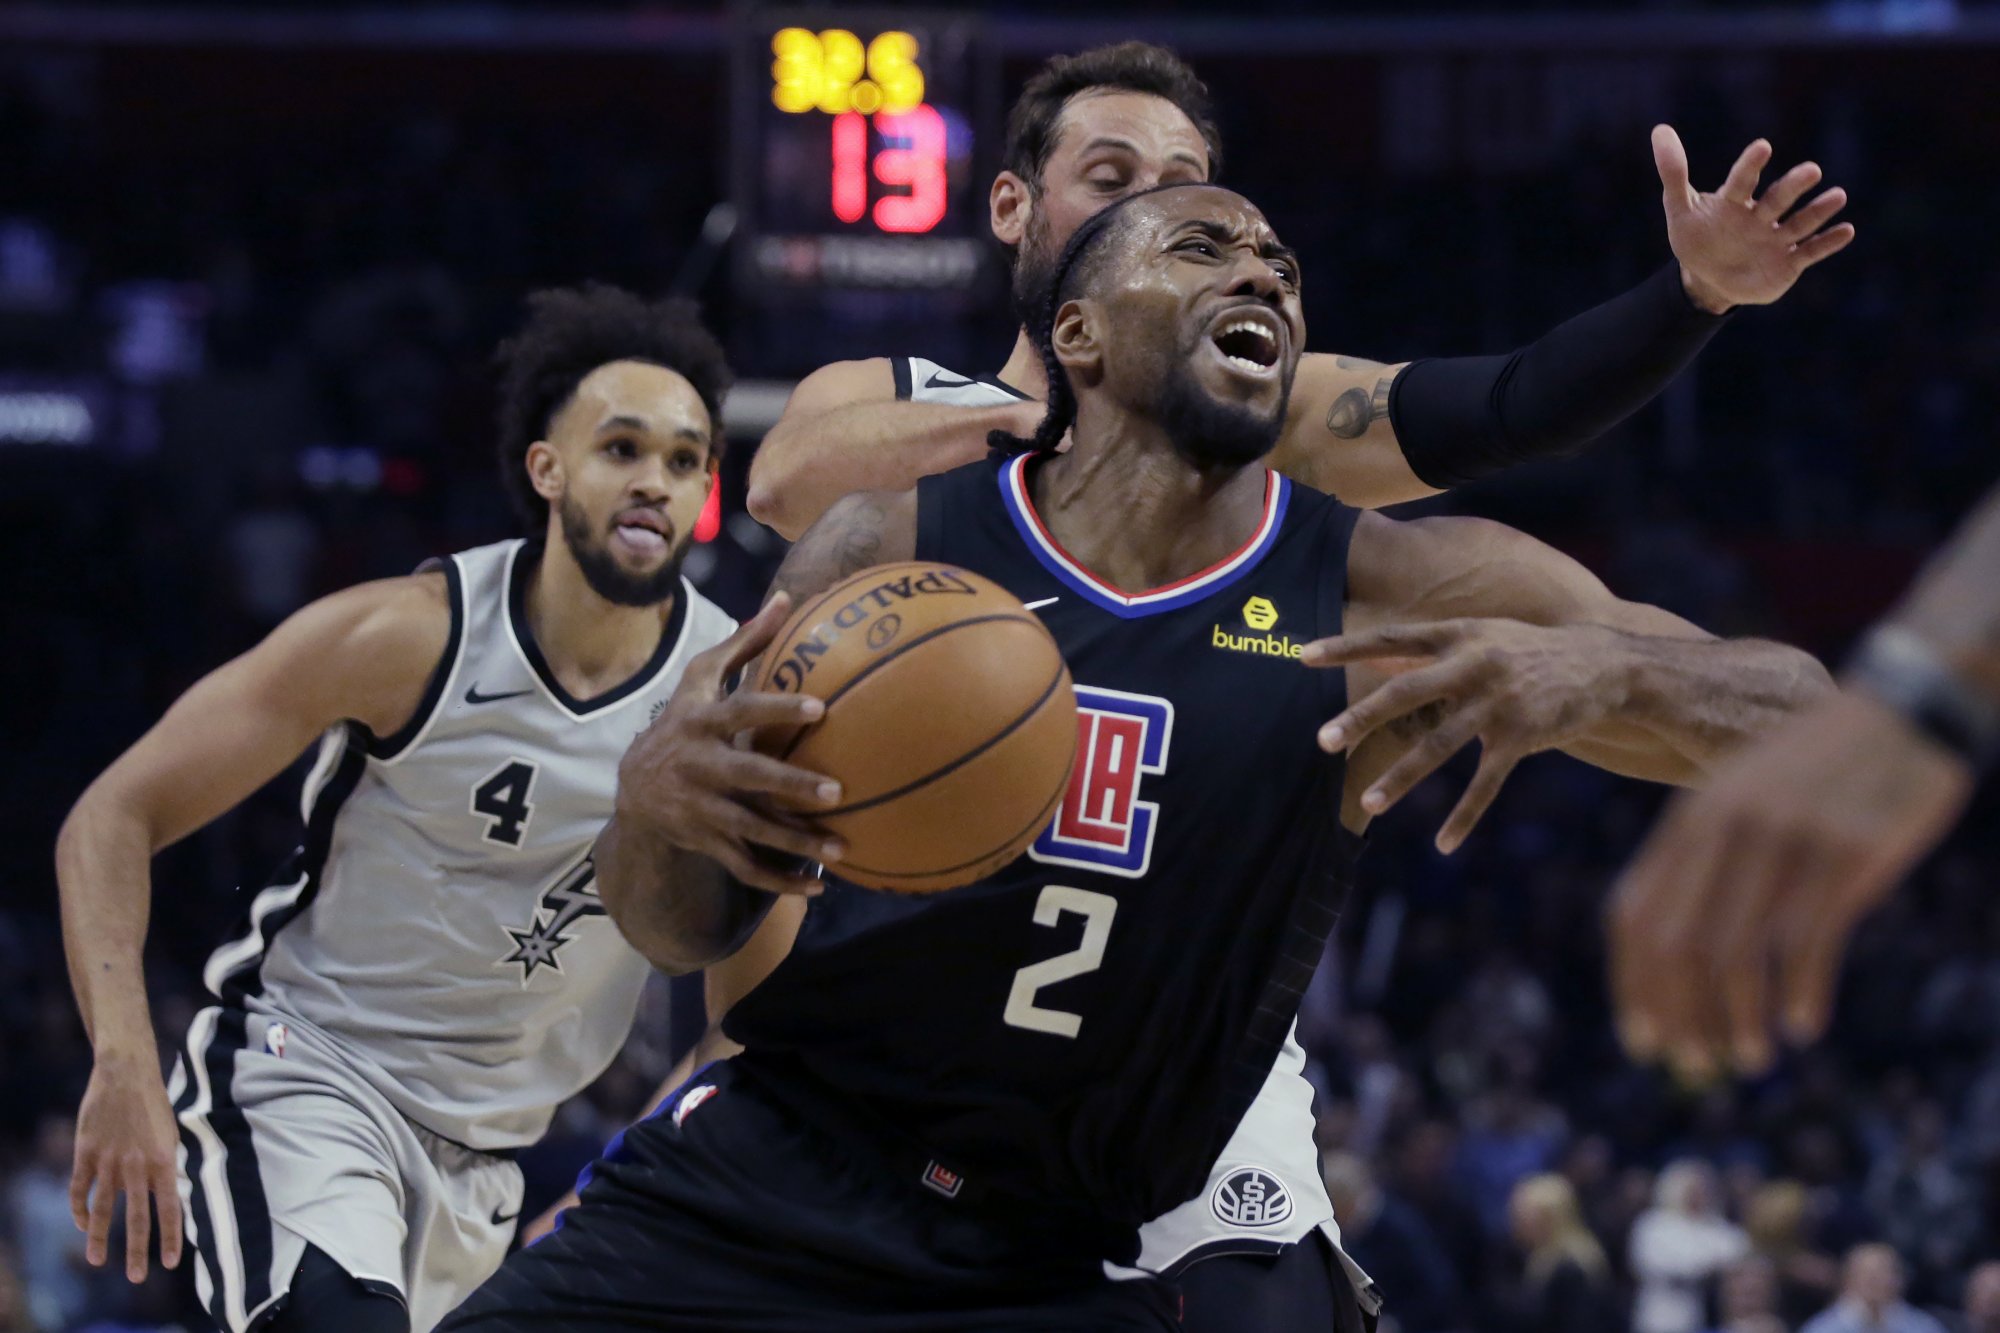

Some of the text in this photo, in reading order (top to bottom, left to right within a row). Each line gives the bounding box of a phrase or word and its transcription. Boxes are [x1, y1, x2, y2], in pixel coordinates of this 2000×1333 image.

[832, 103, 948, 234] 13
[1211, 624, 1304, 659] bumble
[469, 756, 541, 851] 4
[1003, 884, 1118, 1039] 2
